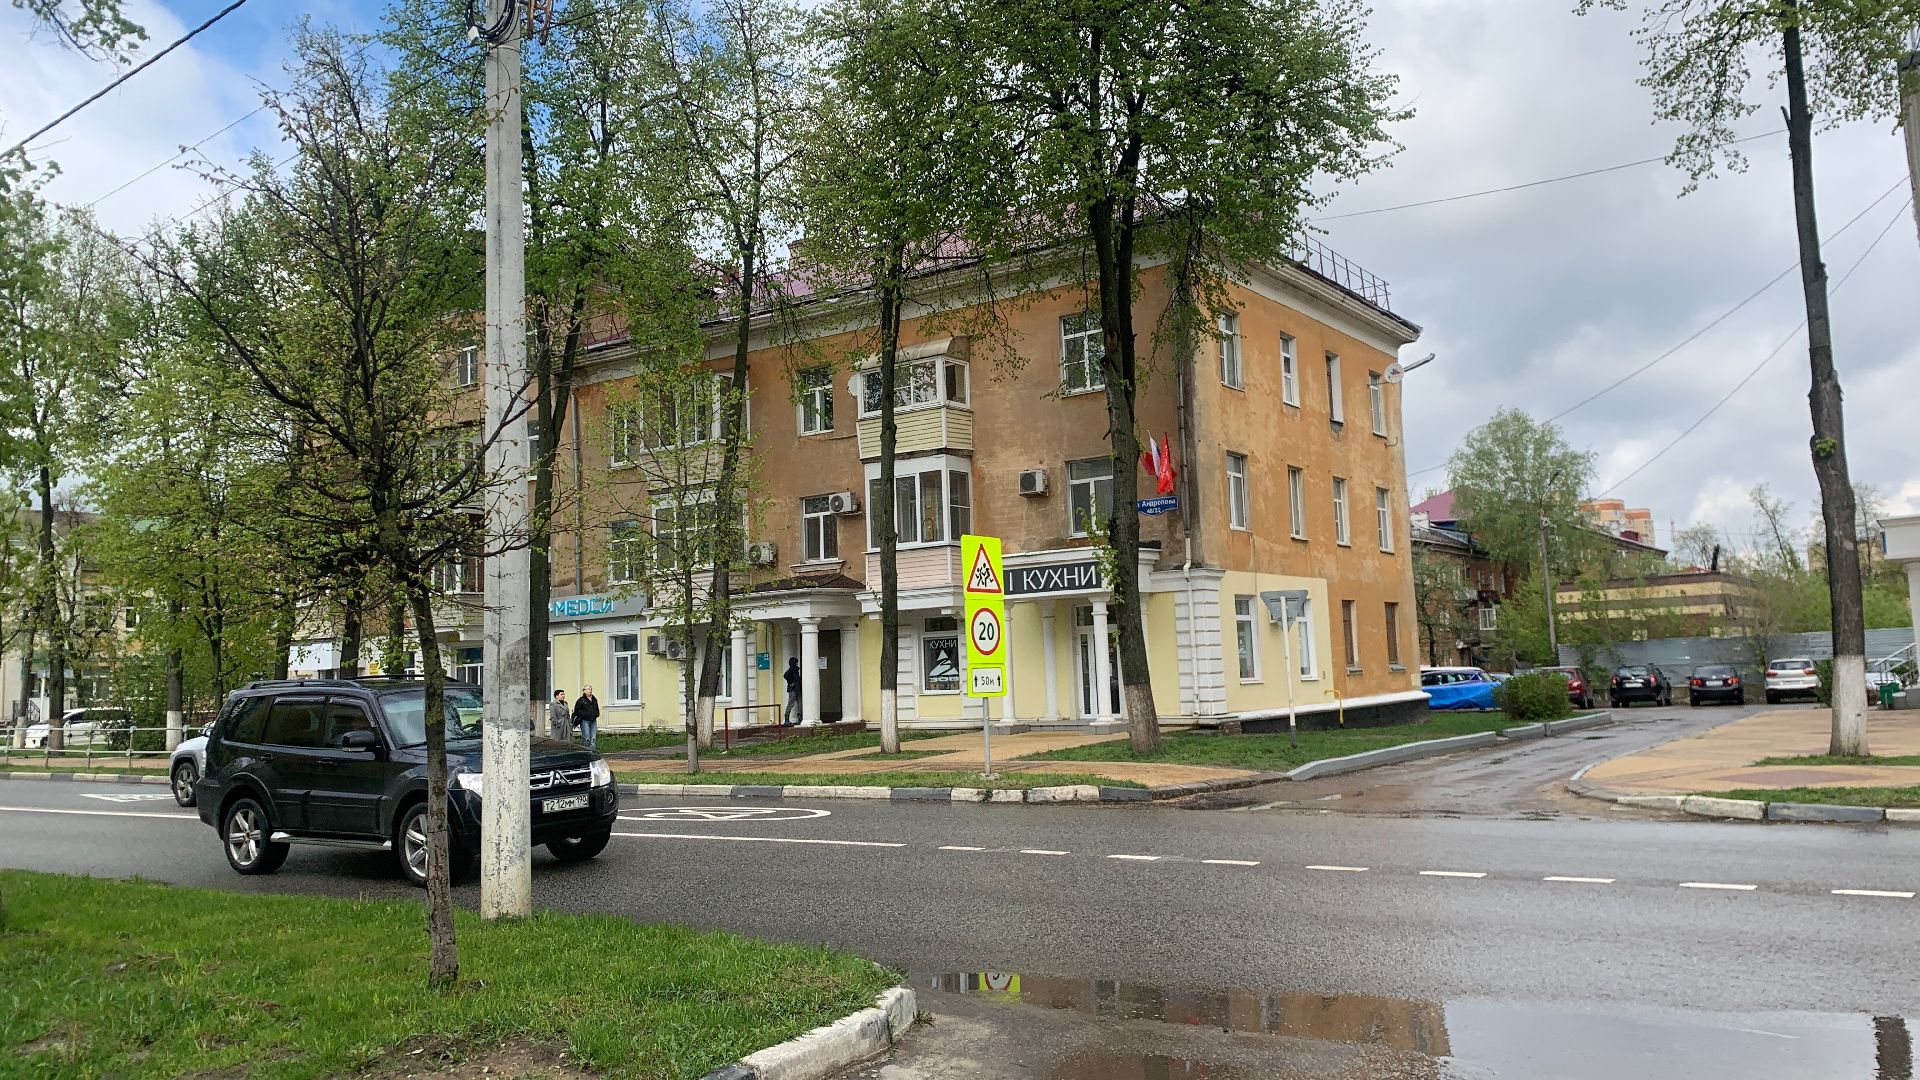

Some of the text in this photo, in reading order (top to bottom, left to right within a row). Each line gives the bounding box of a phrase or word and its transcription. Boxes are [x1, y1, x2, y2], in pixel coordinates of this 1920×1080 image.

[1023, 565, 1097, 591] КУХНИ
[979, 622, 995, 640] 20
[929, 639, 957, 649] КУХНИ
